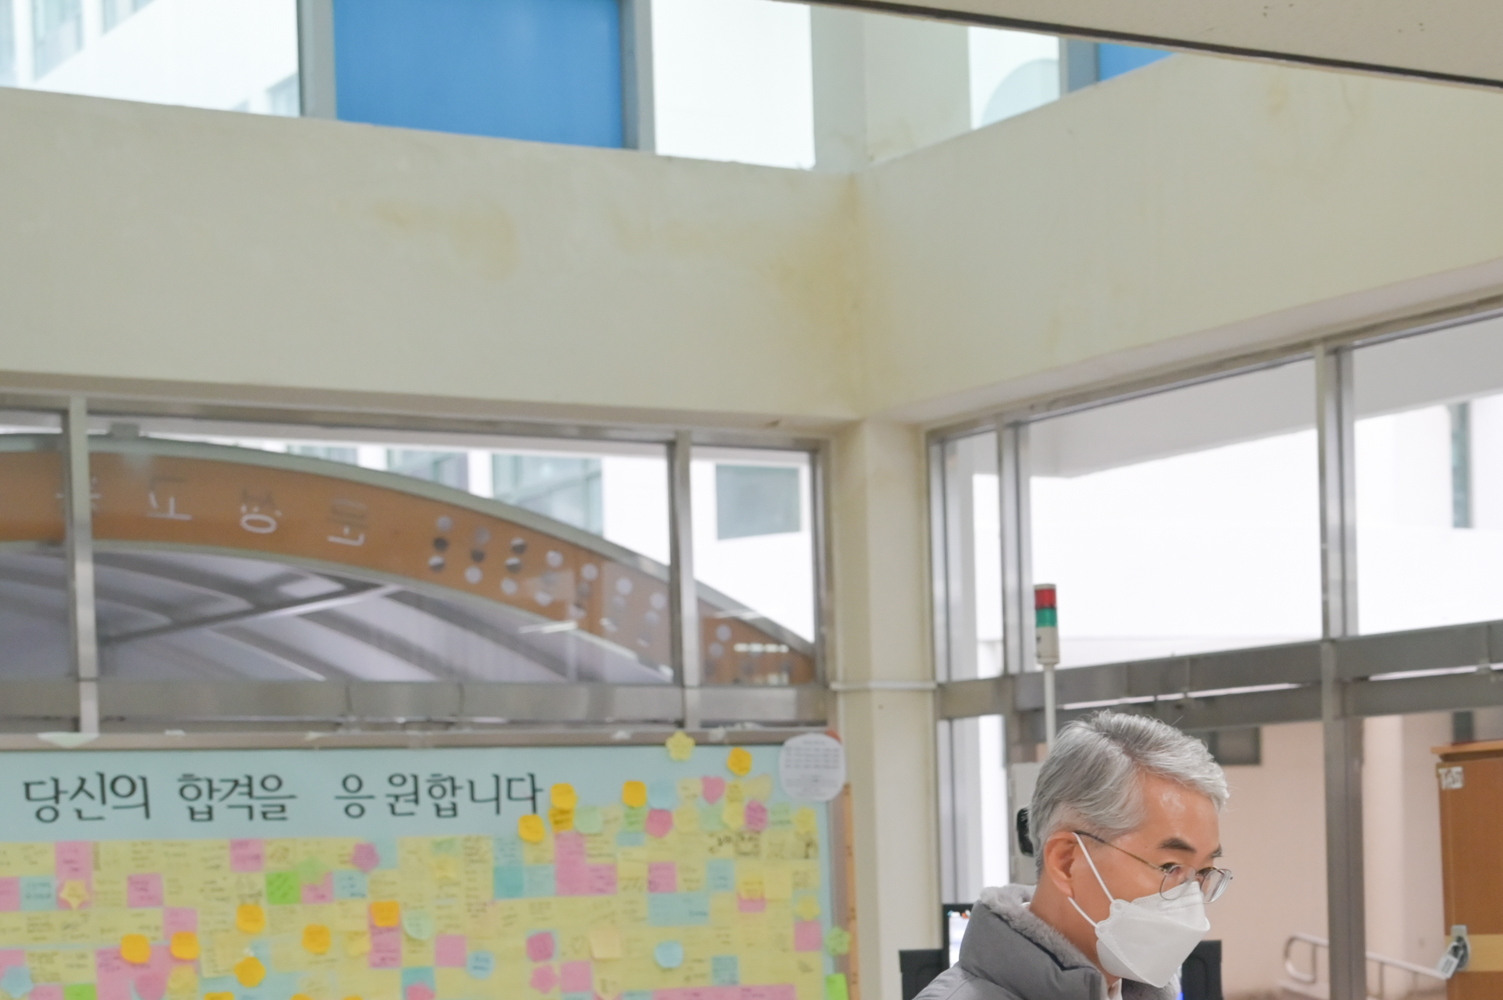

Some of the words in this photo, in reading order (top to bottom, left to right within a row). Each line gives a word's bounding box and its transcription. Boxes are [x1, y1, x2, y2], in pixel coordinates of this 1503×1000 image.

[23, 772, 151, 823] 당신의
[176, 774, 298, 822] 합격을
[335, 772, 543, 820] 응원합니다
